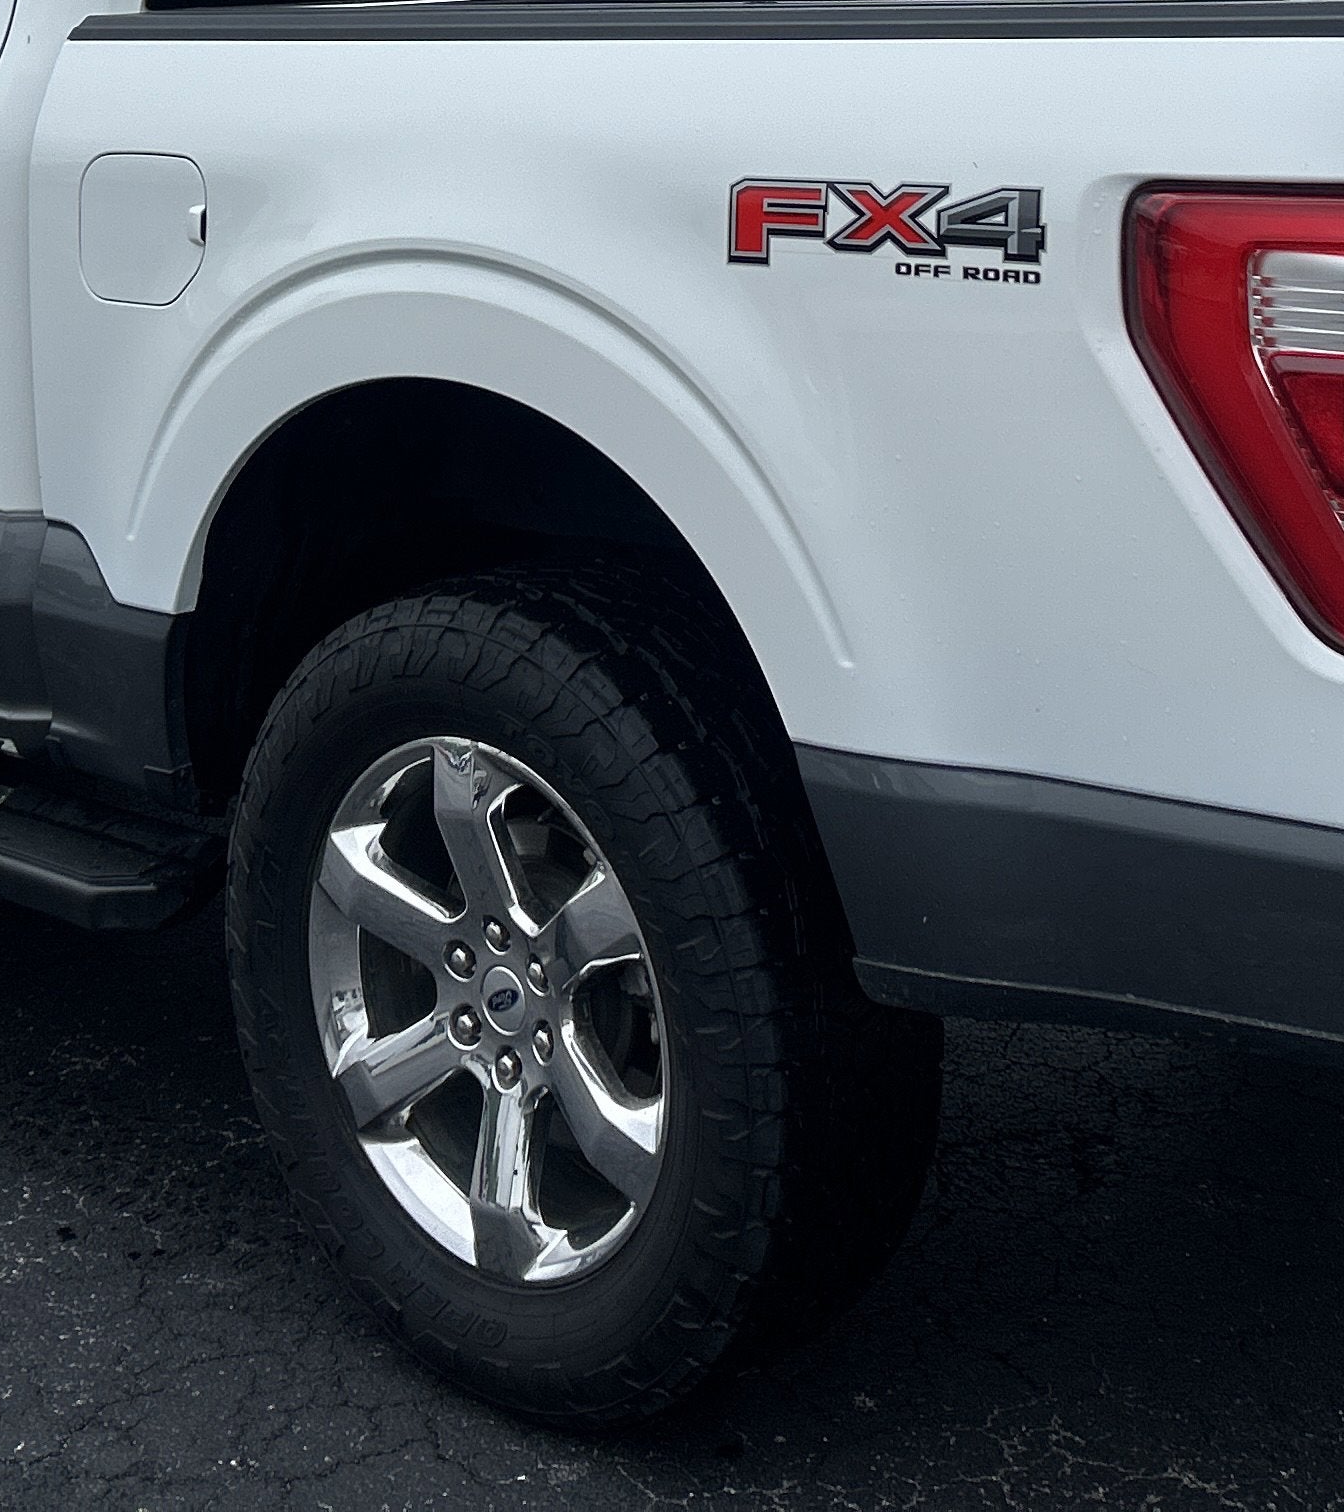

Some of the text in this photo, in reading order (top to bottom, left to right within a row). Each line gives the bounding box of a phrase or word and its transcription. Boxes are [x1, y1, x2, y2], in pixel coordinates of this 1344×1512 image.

[727, 178, 1047, 266] FX4
[894, 262, 1042, 285] OFF ROAD
